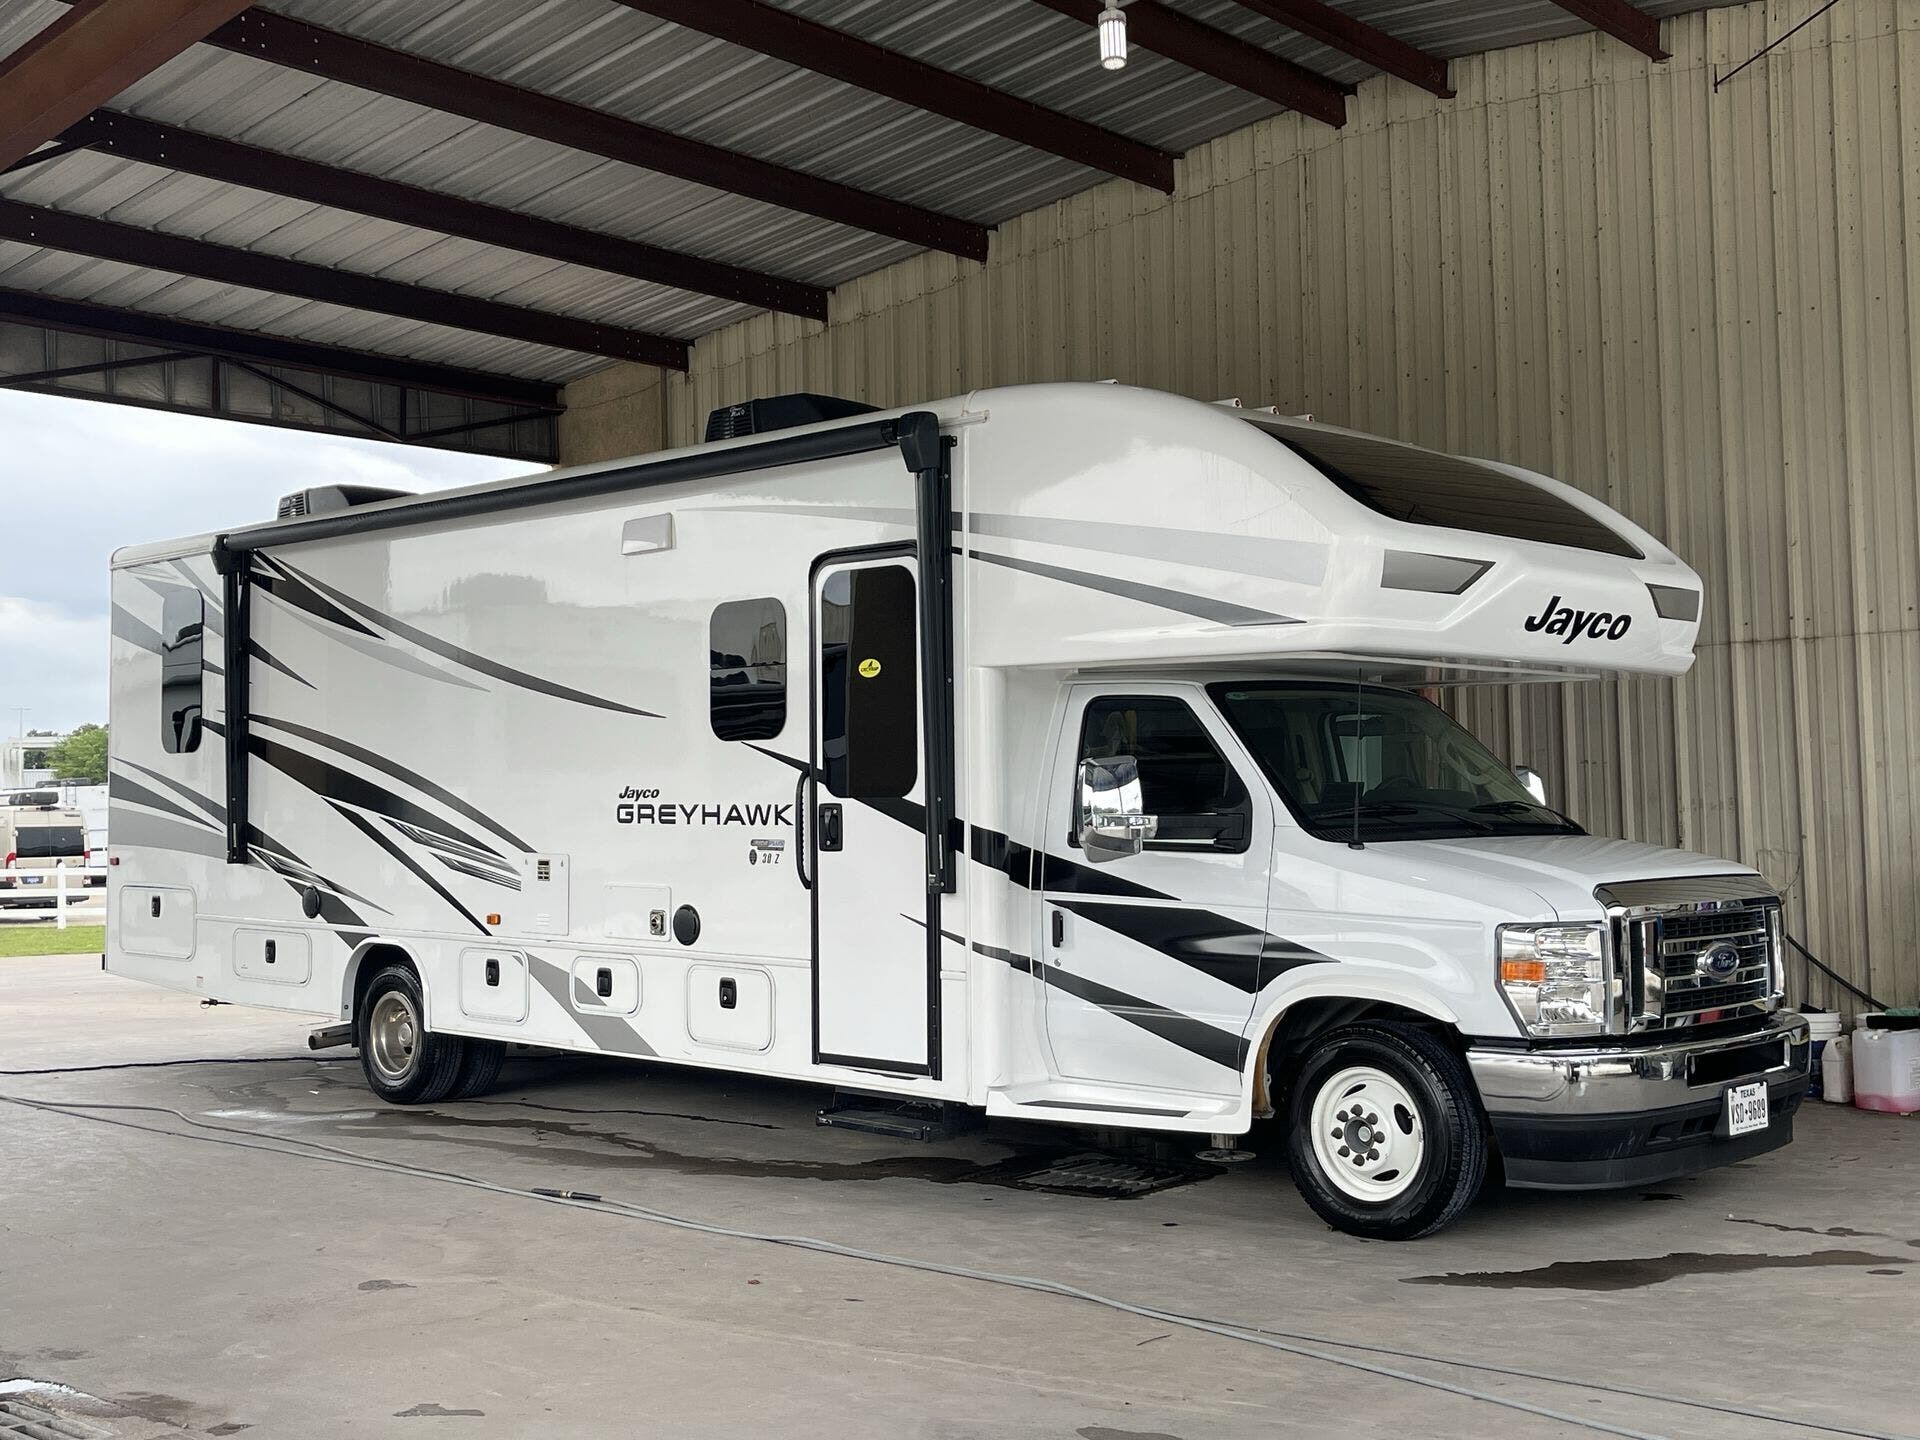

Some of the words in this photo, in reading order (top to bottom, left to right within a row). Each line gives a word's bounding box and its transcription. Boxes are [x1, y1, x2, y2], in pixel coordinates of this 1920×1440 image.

[1524, 595, 1632, 645] Jayco
[618, 785, 660, 802] Jayco
[616, 803, 794, 826] GREYHAWK
[1740, 1088, 1756, 1099] TEXAS
